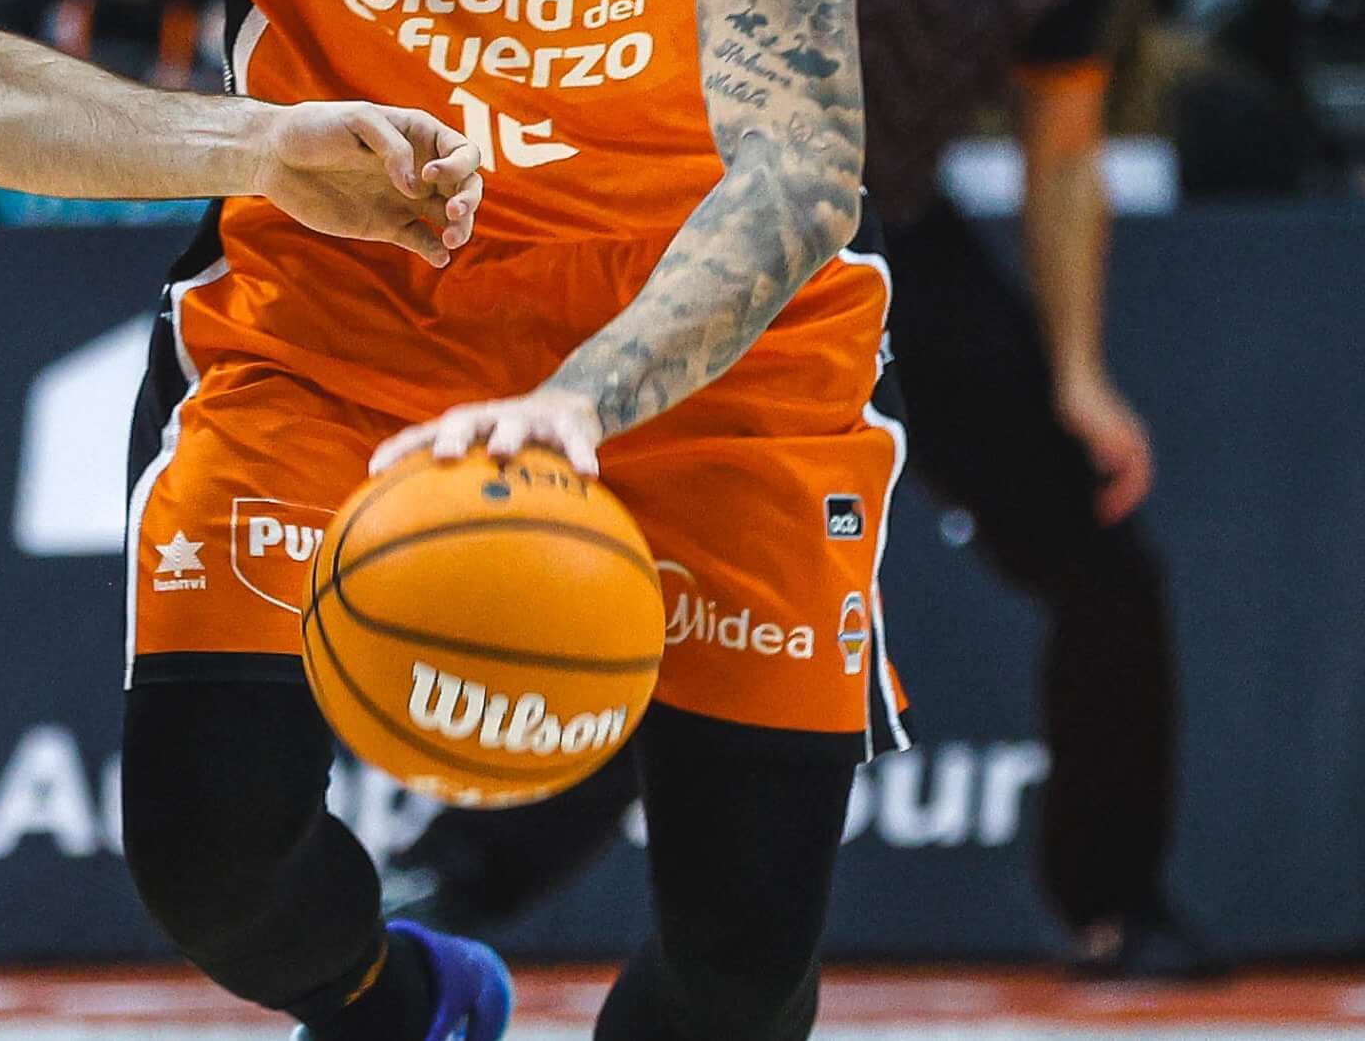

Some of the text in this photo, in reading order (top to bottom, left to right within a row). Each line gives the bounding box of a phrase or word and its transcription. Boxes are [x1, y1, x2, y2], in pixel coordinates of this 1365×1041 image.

[395, 16, 655, 90] fuerzo
[665, 591, 815, 660] Midea
[408, 660, 627, 757] Wilson
